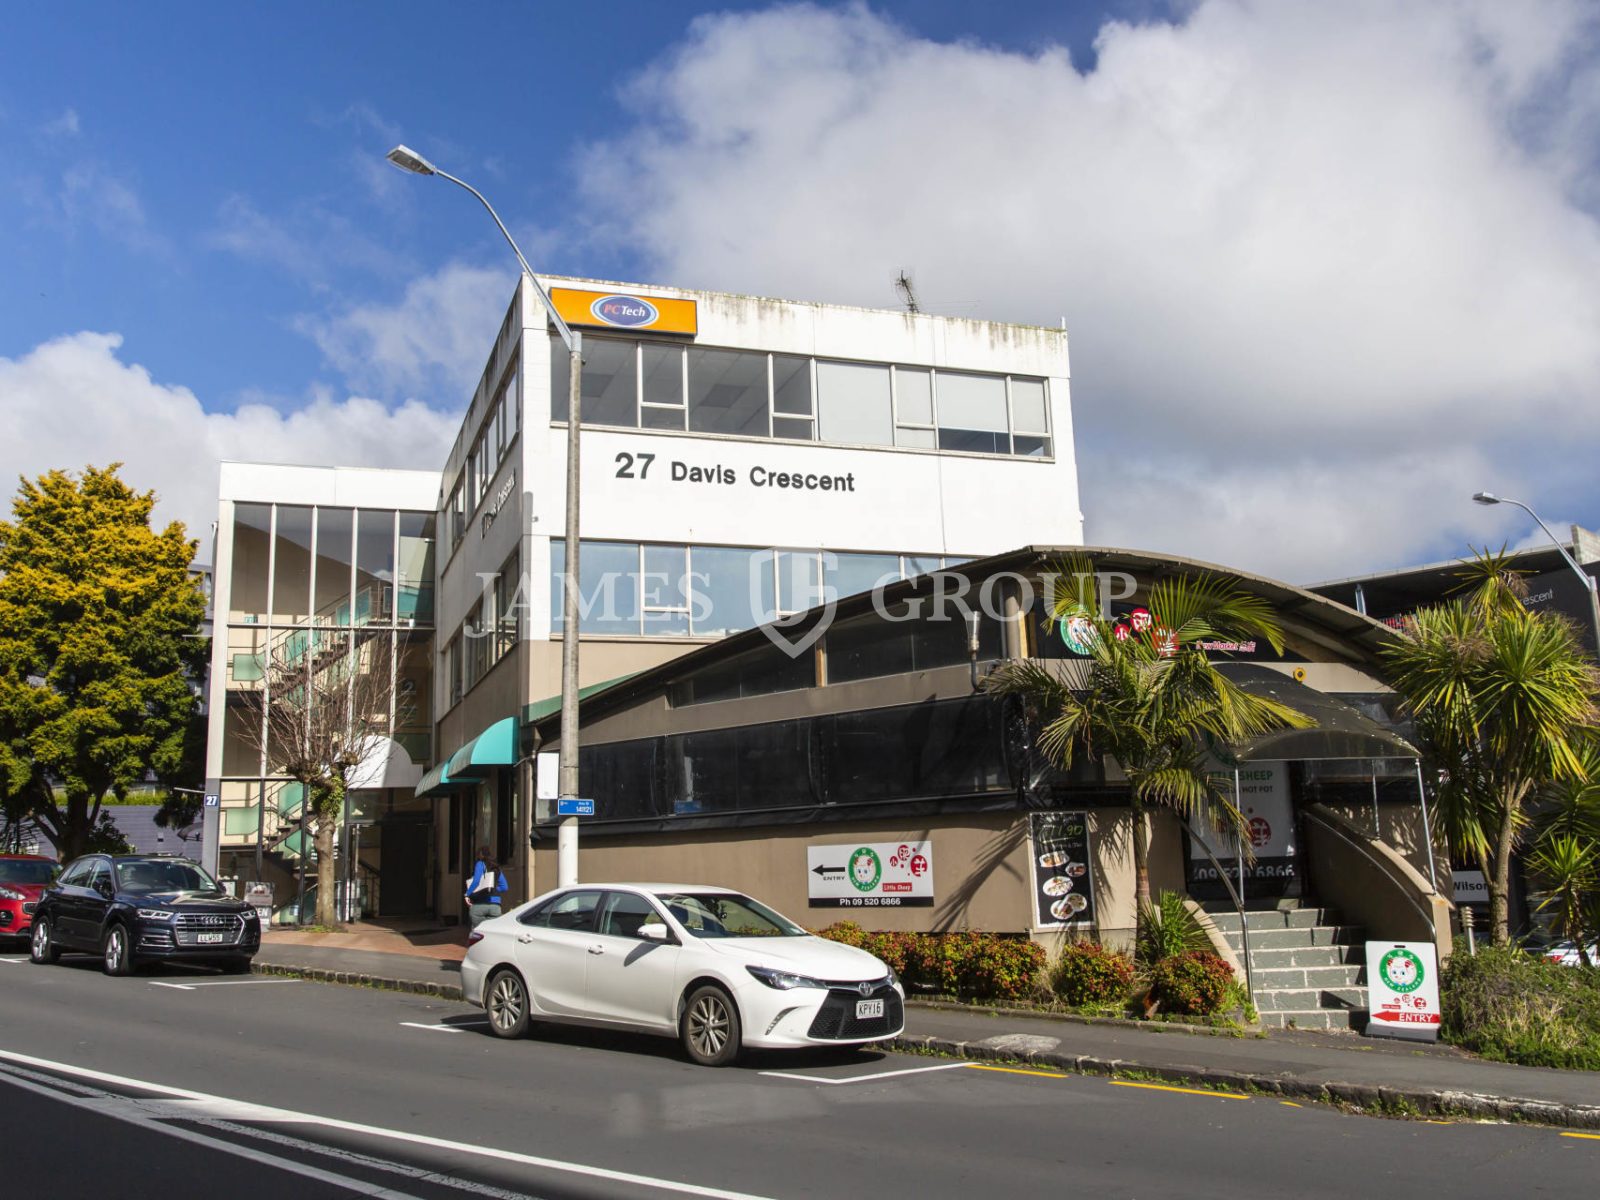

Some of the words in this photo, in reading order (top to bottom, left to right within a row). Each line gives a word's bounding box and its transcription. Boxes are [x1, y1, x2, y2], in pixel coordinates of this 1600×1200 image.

[603, 303, 621, 315] PC
[621, 305, 646, 317] Tech
[614, 452, 656, 480] 27
[671, 461, 736, 485] Davis
[749, 466, 855, 492] Crescent
[1239, 769, 1274, 780] SHEEP
[1242, 785, 1257, 794] HOT
[1258, 785, 1274, 794] POT
[206, 795, 218, 806] 27
[839, 898, 851, 906] Ph
[852, 898, 863, 906] 09
[864, 897, 879, 906] 520
[880, 897, 901, 905] 6866
[859, 1002, 881, 1015] KPY16
[1399, 1013, 1433, 1023] ENTRY
